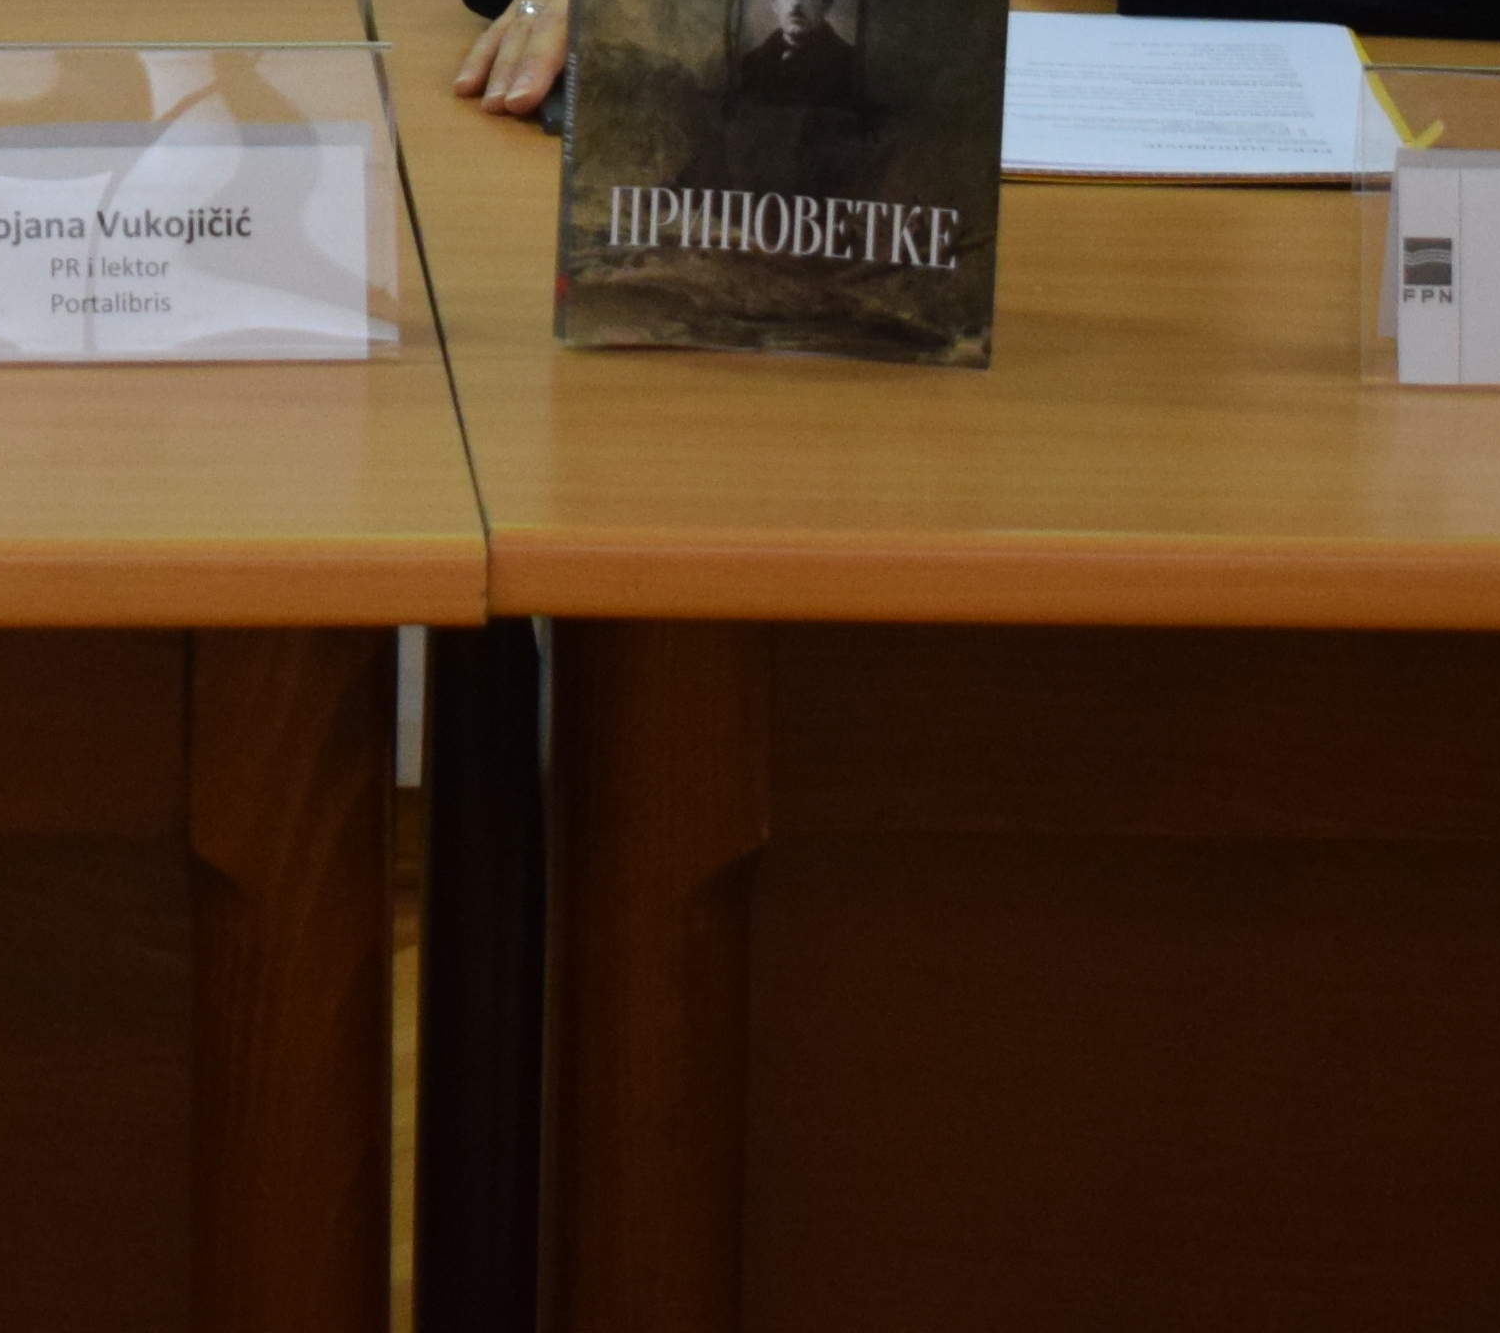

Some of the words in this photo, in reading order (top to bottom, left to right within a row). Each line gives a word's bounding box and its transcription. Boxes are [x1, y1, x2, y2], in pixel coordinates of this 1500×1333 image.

[96, 208, 251, 244] Vukojičić
[607, 184, 958, 270] ПРИПОВЕТКЕ
[51, 257, 80, 278] PR
[101, 256, 169, 278] lektor
[51, 292, 171, 314] Portalibris
